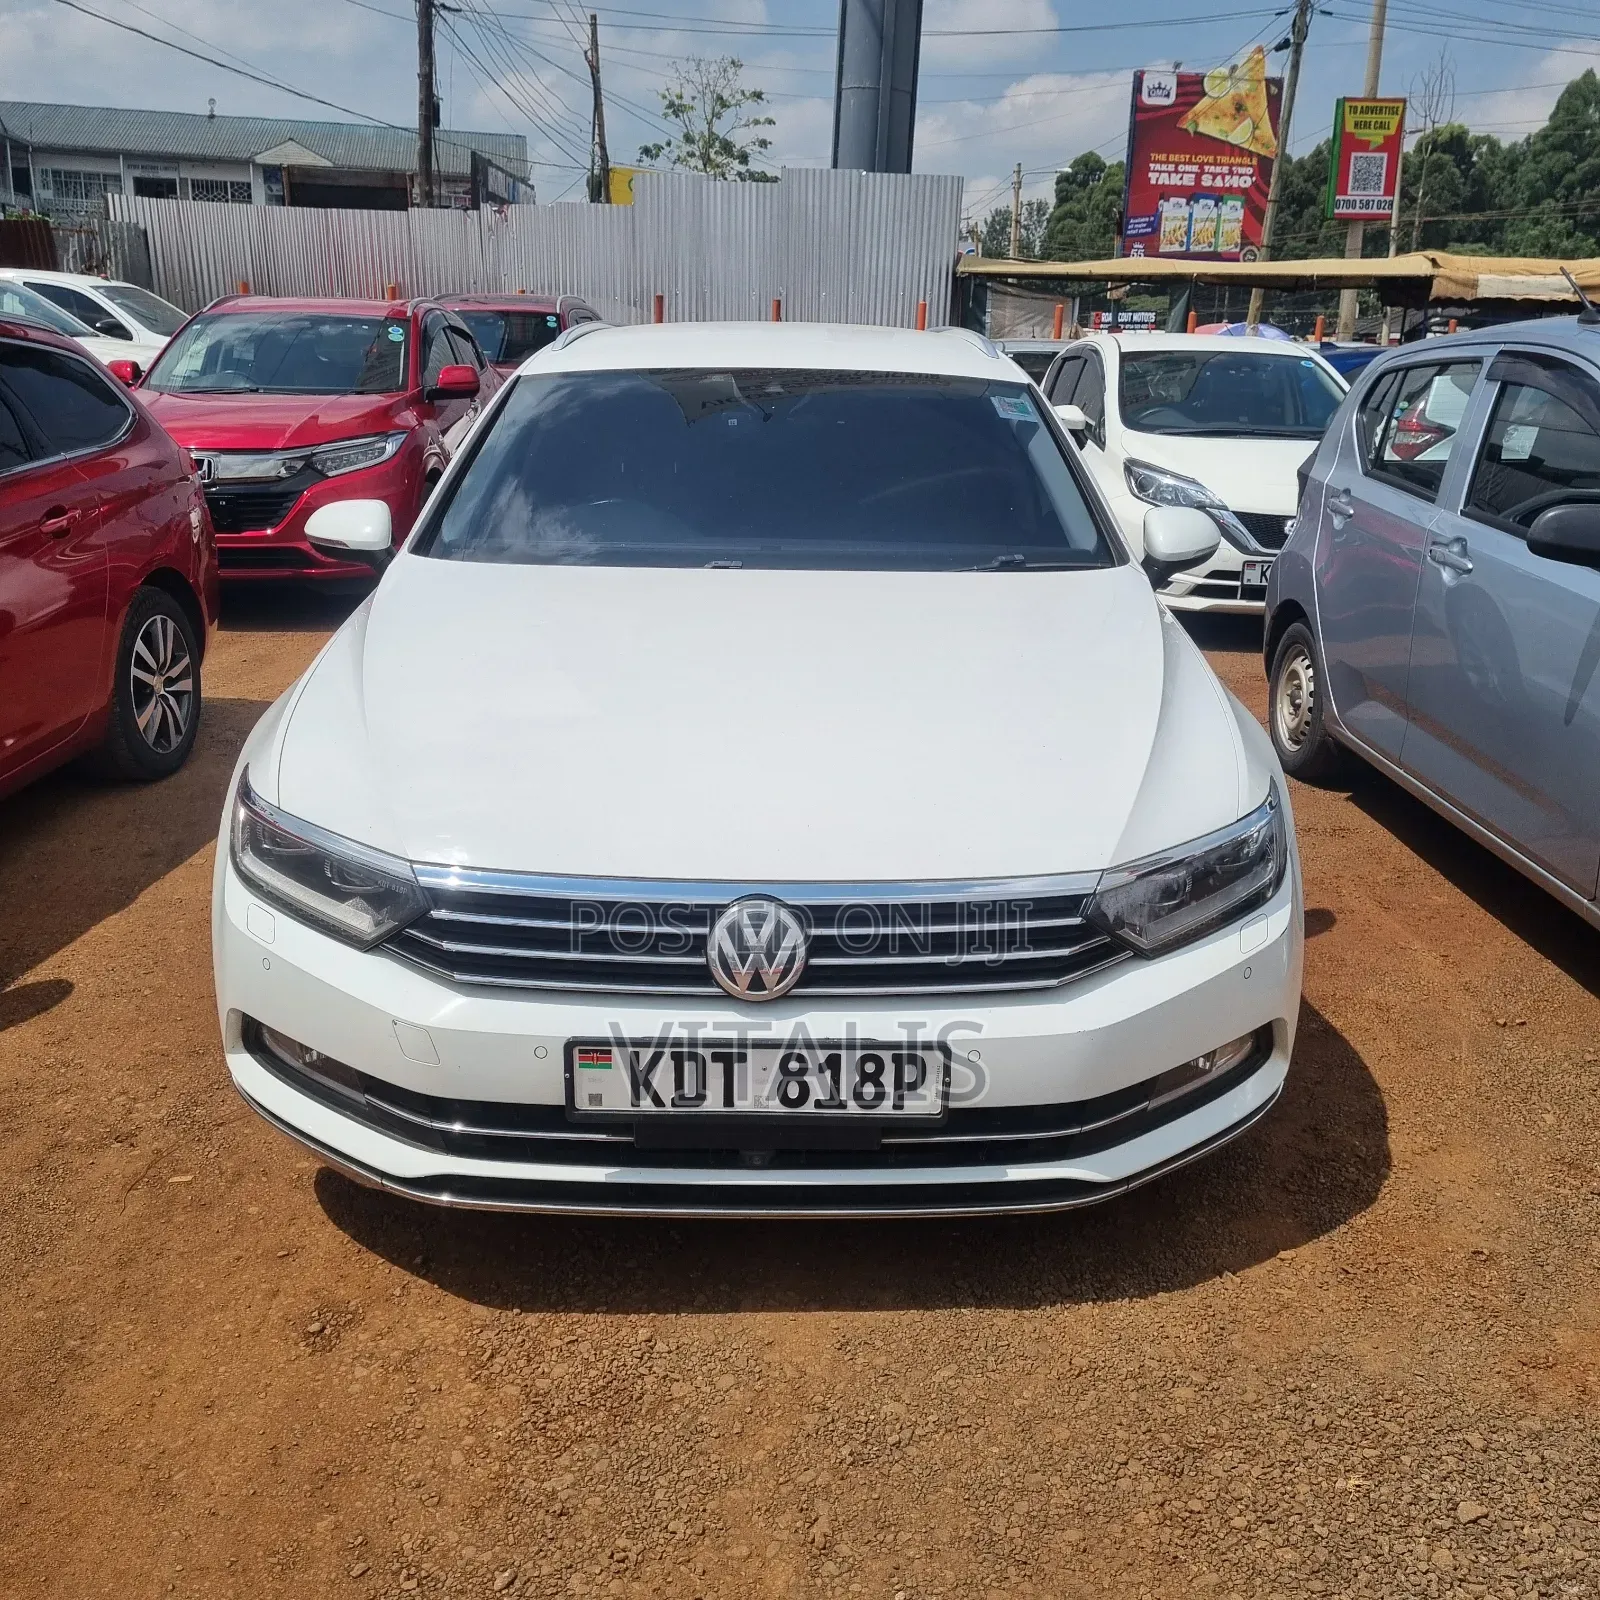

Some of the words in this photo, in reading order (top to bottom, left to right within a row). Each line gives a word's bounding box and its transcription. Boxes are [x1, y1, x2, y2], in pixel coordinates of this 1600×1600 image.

[1348, 105, 1358, 115] TO
[1360, 105, 1400, 116] ADVERTISE
[1353, 120, 1373, 130] HERE
[1373, 120, 1391, 130] CALL
[1150, 153, 1167, 161] THE
[1169, 154, 1190, 162] BEST
[1192, 155, 1215, 163] LOVE
[1216, 156, 1258, 165] TRIANGLE
[1149, 163, 1175, 171] TAKE
[1204, 165, 1229, 173] TAKE
[1232, 166, 1254, 175] TWO
[1148, 172, 1196, 186] TAKE
[1335, 199, 1357, 210] 0700
[1358, 199, 1374, 210] 587
[1376, 199, 1394, 210] 028
[629, 1050, 748, 1108] KDT
[776, 1052, 928, 1111] 818P
